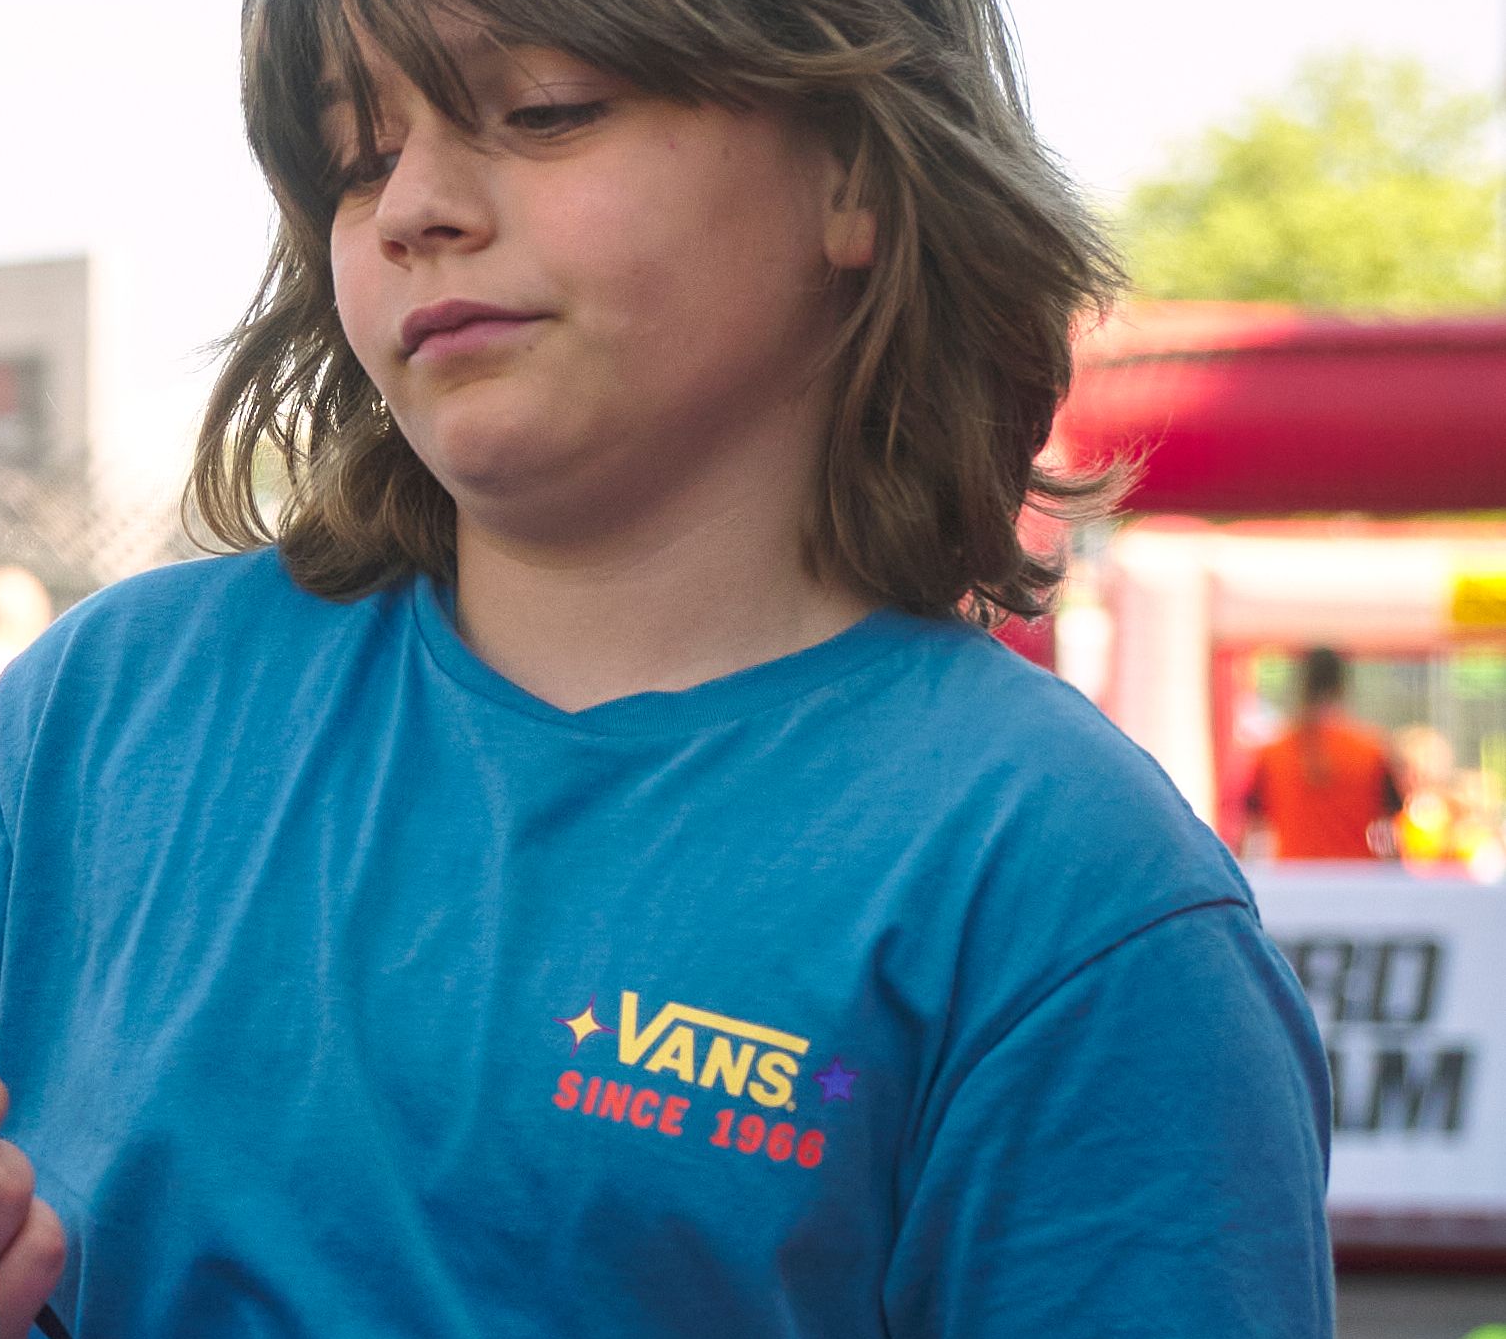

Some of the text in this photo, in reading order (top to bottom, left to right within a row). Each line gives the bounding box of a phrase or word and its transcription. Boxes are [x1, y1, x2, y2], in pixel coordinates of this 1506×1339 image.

[617, 989, 811, 1109] VANS
[551, 1069, 829, 1170] SINCE 1966
